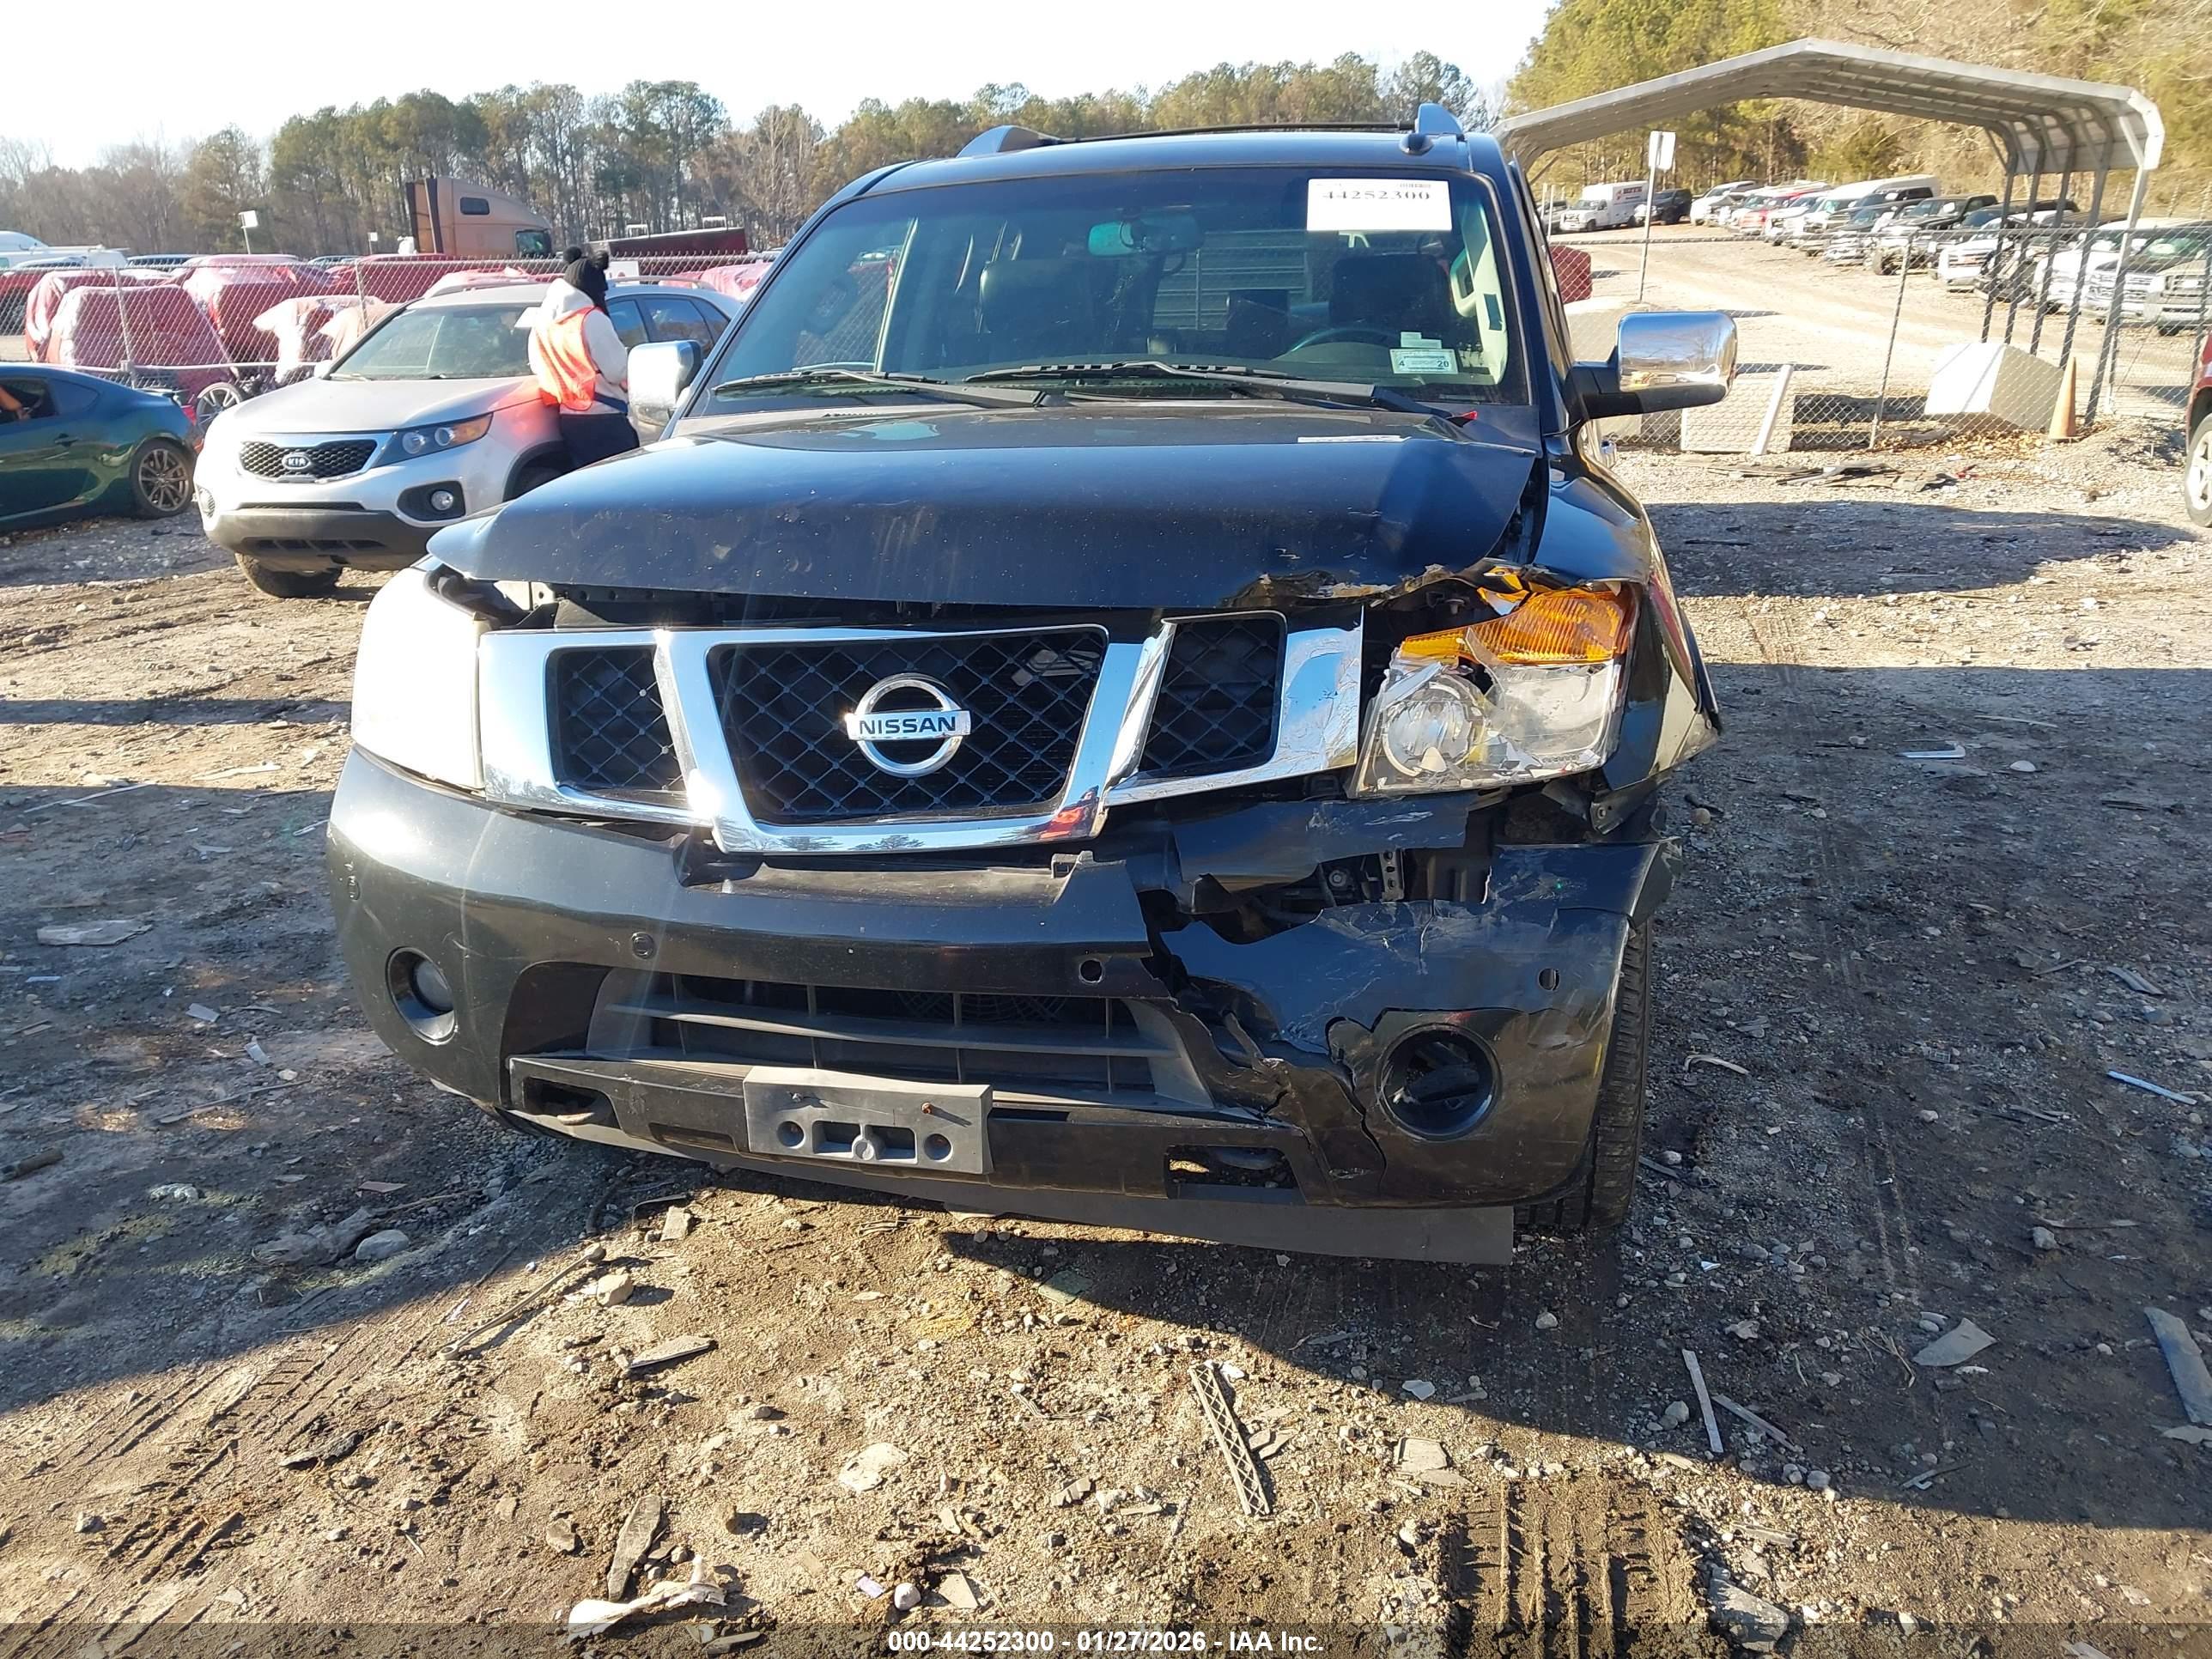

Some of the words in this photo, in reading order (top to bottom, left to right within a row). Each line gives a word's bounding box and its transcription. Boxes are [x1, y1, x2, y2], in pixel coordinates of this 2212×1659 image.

[1322, 190, 1431, 200] 44252300
[288, 457, 307, 466] KIA
[859, 715, 957, 735] NISSAN
